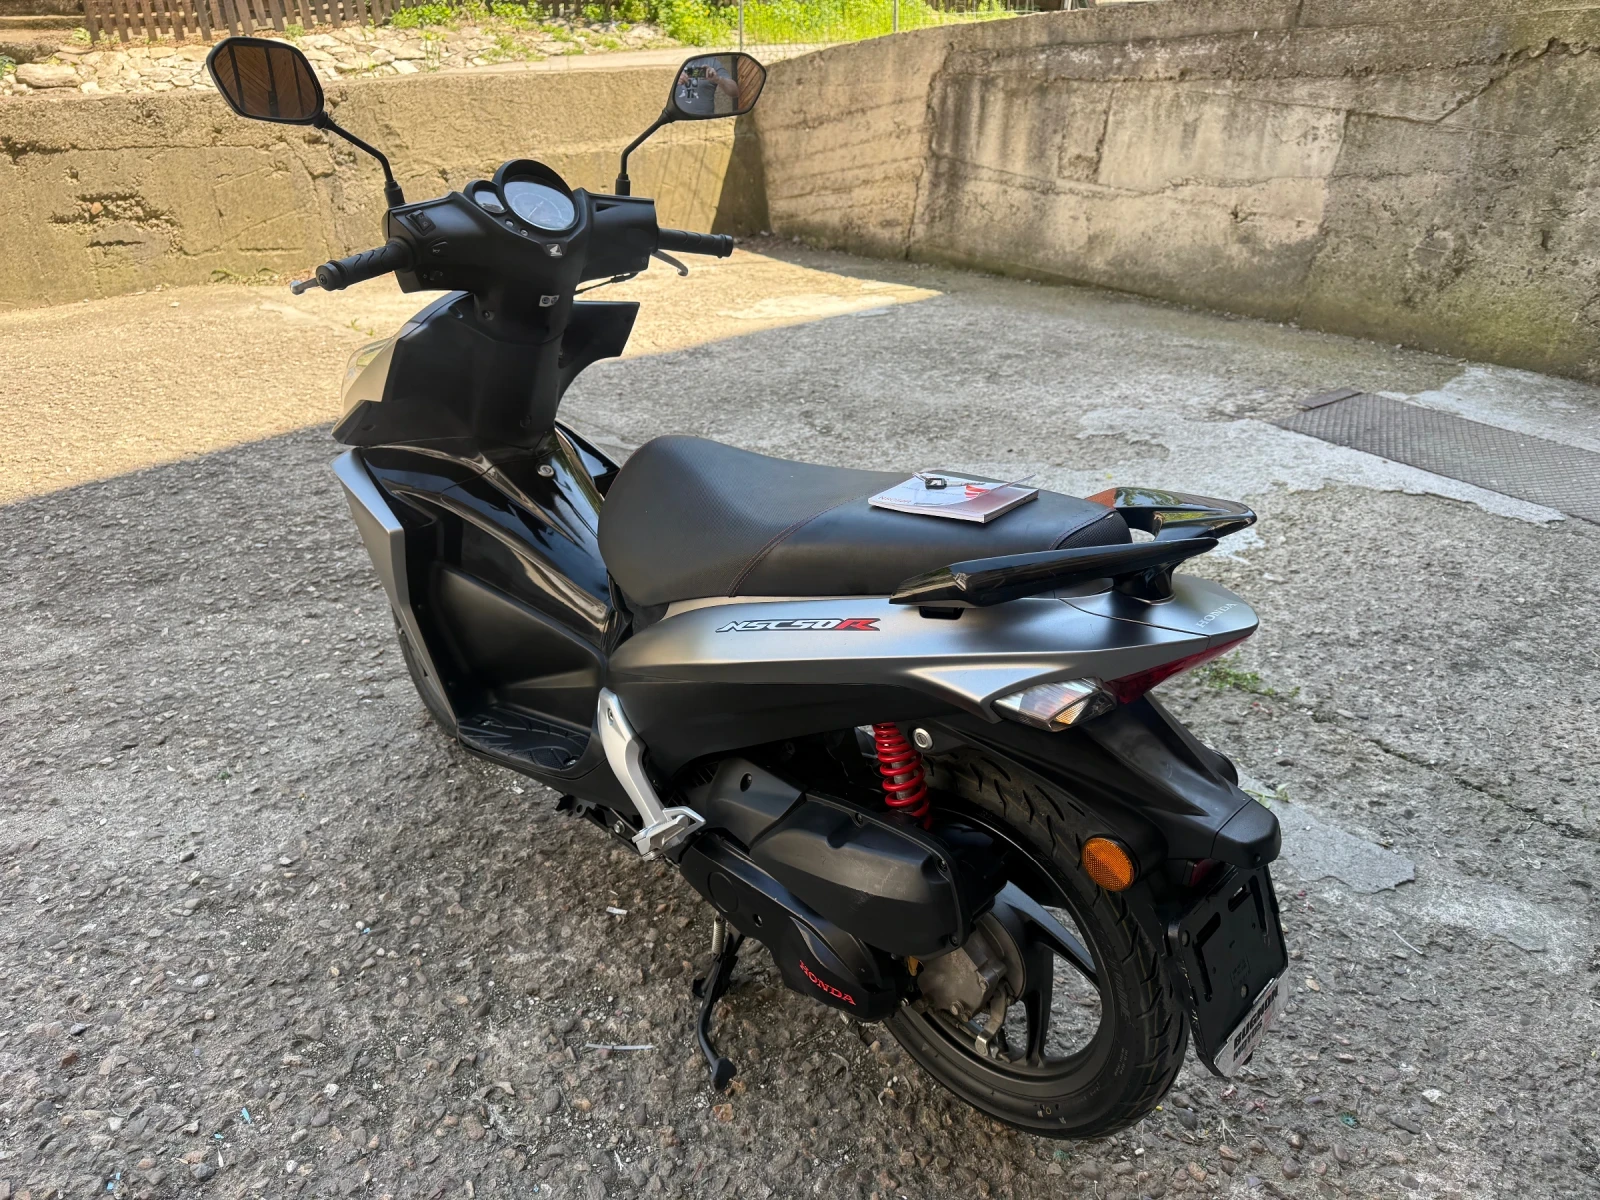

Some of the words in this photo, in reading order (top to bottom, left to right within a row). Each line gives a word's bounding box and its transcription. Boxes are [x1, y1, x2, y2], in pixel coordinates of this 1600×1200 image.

[715, 618, 881, 633] NSC50R
[1195, 603, 1238, 628] HONDA
[799, 960, 856, 1006] HONDA
[1233, 985, 1279, 1051] BUGNON
[1233, 1019, 1263, 1062] MOTOS
